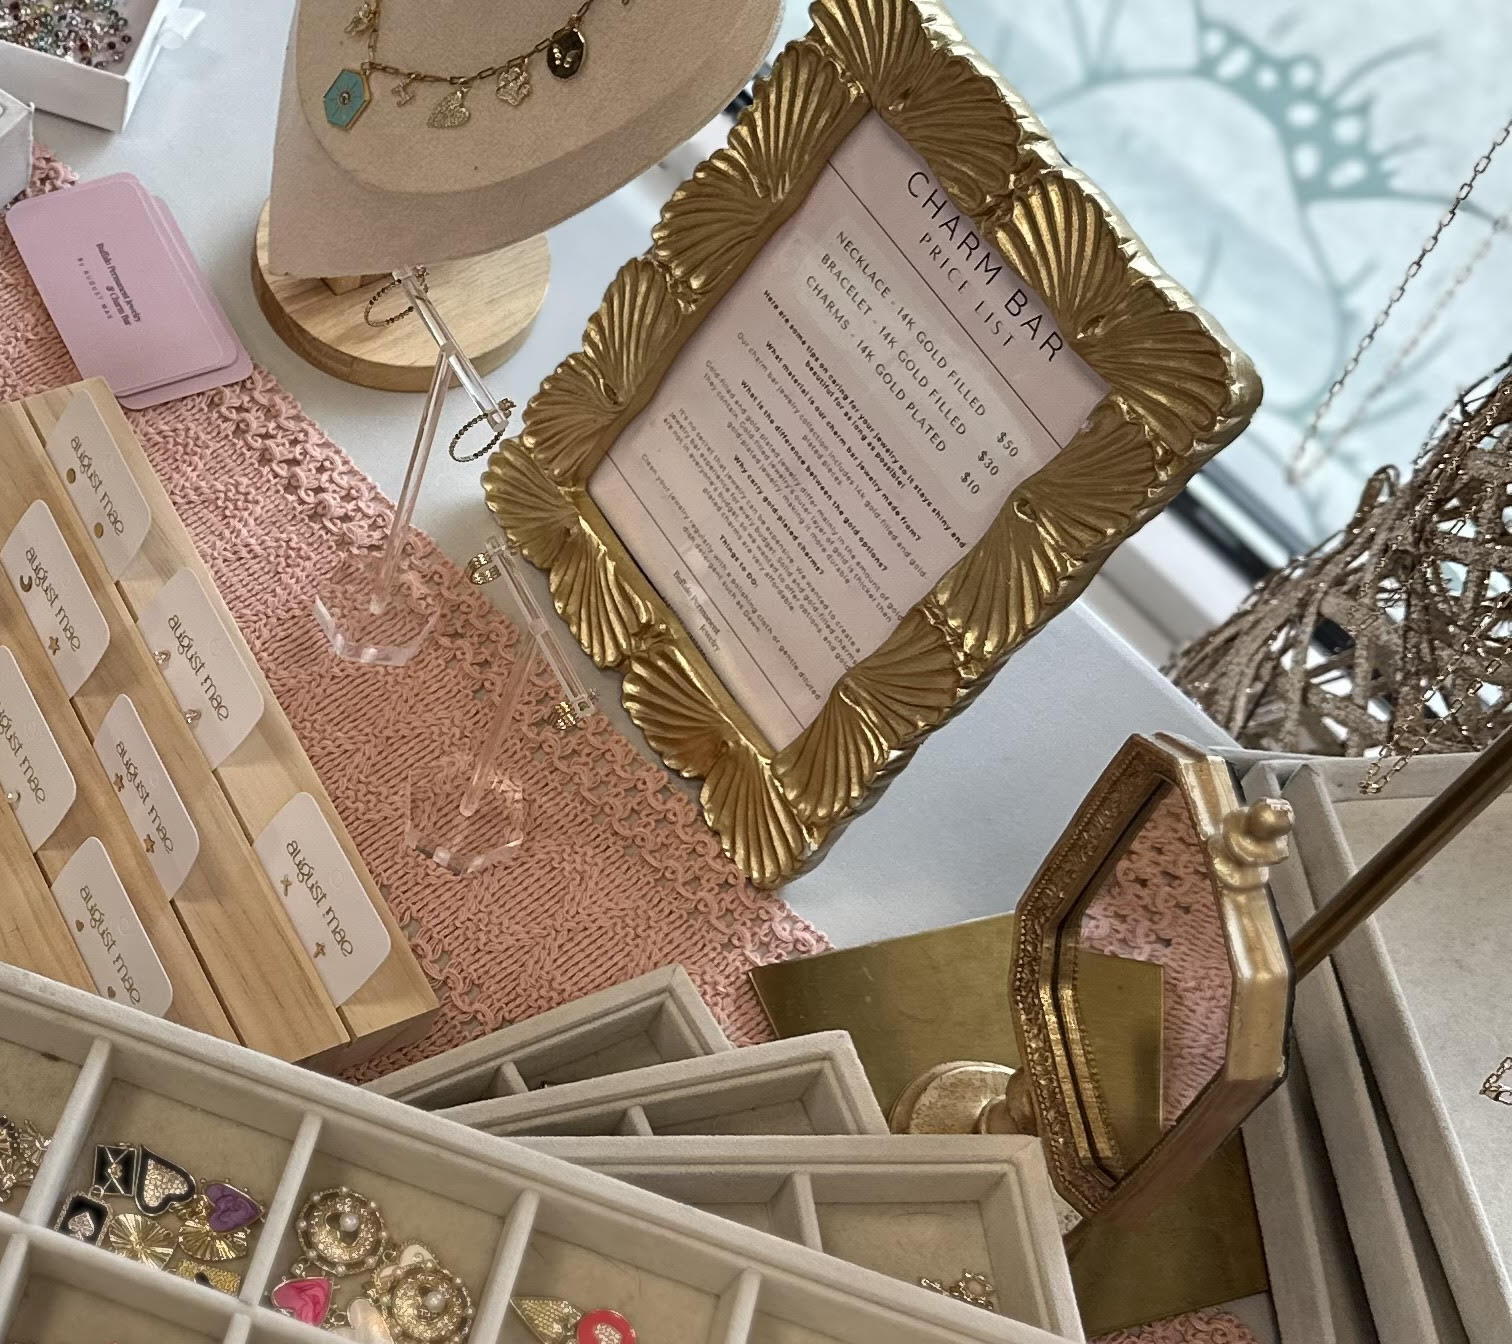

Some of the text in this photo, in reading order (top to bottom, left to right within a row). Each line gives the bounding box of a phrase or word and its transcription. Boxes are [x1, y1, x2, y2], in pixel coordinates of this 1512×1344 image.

[908, 171, 1064, 362] CHARM BAR
[919, 232, 1014, 346] PRICE LIST
[806, 276, 980, 494] CHARMS 14K GOLD PLATED $10
[821, 253, 999, 475] BRACELET 14K GOLD FILLED $30
[836, 231, 1018, 457] NECKLACE 14K GOLD FILLED $50
[741, 380, 888, 571] What is the difference between the gold options?
[764, 290, 966, 548] Here are some tips on caring for your jewelry so it stays shiny and
[766, 341, 921, 541] What material is our charm bar jewelry made from?
[70, 435, 125, 537] august mae
[734, 454, 824, 574] Why carry gold-plated charms?
[25, 546, 81, 652] august mae
[719, 534, 739, 562] Things
[739, 562, 746, 571] to
[167, 614, 230, 722] august mae
[19, 755, 46, 805] mae
[115, 740, 174, 854] august mae
[79, 885, 141, 1006] august mae
[286, 839, 355, 958] august mae
